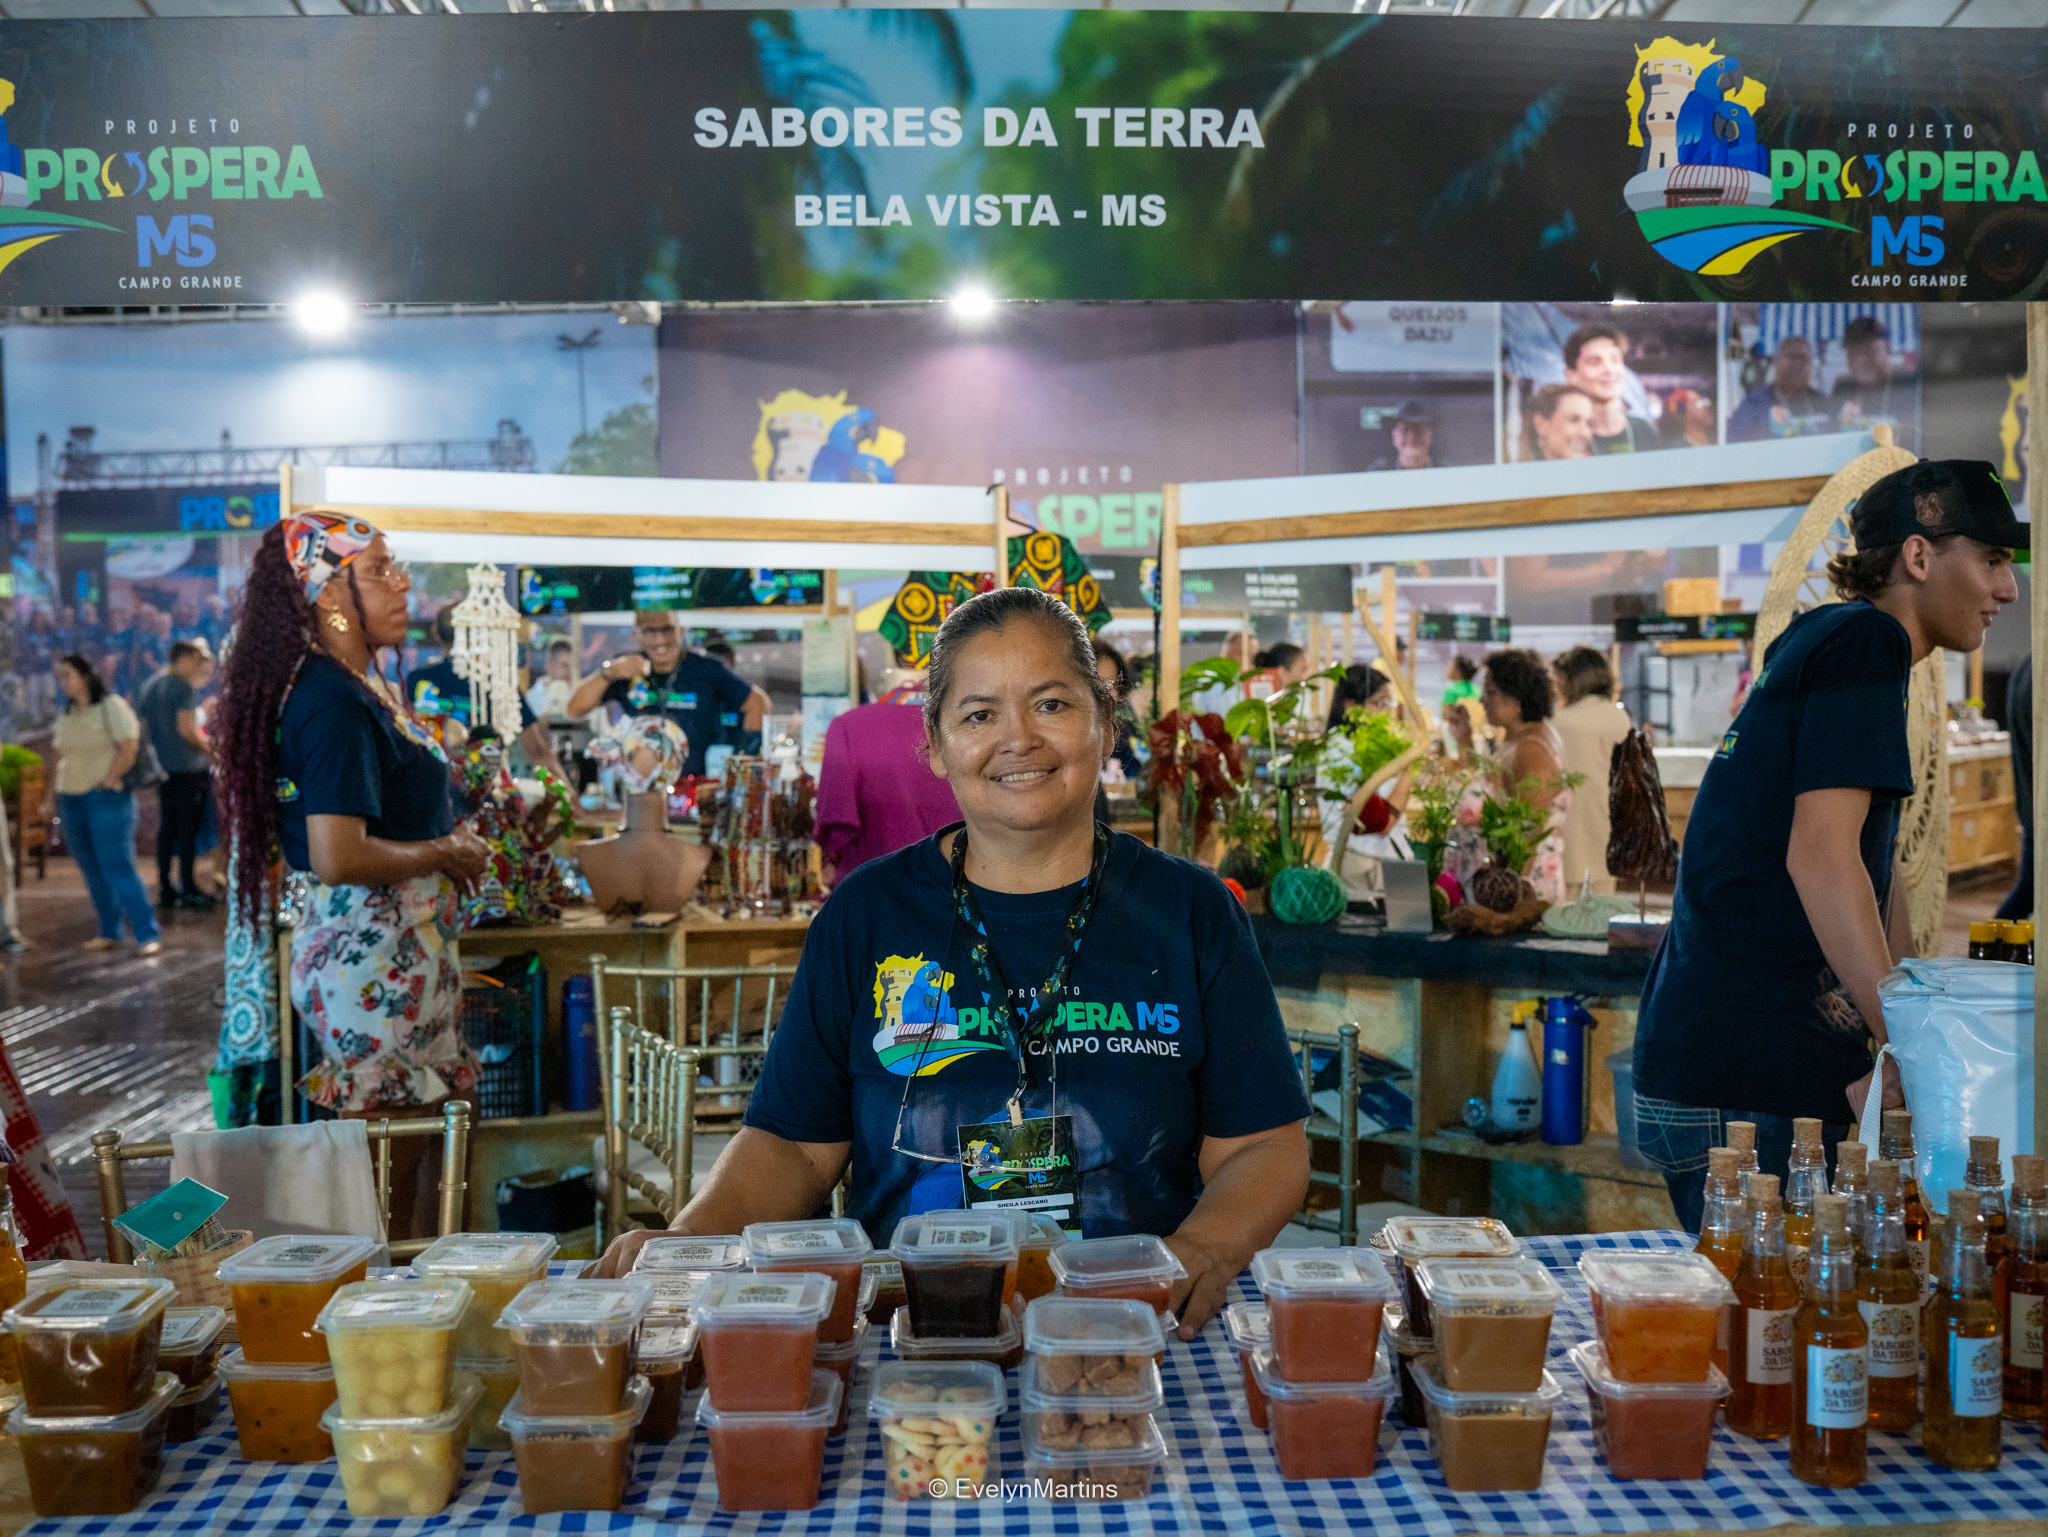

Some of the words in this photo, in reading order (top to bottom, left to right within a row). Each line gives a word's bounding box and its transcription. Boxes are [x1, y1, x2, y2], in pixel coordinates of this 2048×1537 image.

[105, 118, 240, 135] PROJETO
[694, 106, 963, 149] SABORES
[983, 107, 1058, 148] DA
[1075, 107, 1265, 149] TERRA
[1847, 123, 1974, 139] PROJETO
[24, 145, 324, 201] PROSPERA
[1770, 148, 2048, 203] PROSPERA
[794, 194, 912, 227] BELA
[925, 194, 1060, 227] VISTA
[1072, 209, 1087, 219] -
[1101, 193, 1167, 227] MS
[136, 213, 217, 268] MS
[1870, 214, 1945, 267] MS
[118, 276, 172, 289] CAMPO
[180, 275, 243, 289] GRANDE
[1851, 274, 1901, 288] CAMPO
[1909, 274, 1968, 288] GRANDE
[1389, 306, 1468, 322] QUEIJOS
[993, 465, 1132, 487] PROJETO
[1007, 985, 1081, 999] PROTO
[1136, 1001, 1181, 1035] MS
[1028, 1036, 1100, 1056] CAMPO
[1106, 1037, 1182, 1058] GRANDE
[1028, 1170, 1048, 1184] MS
[997, 1201, 1020, 1209] SHEILA
[1020, 1199, 1049, 1207] LESCANO
[1765, 1357, 1778, 1366] DA
[1872, 1350, 1887, 1359] DA
